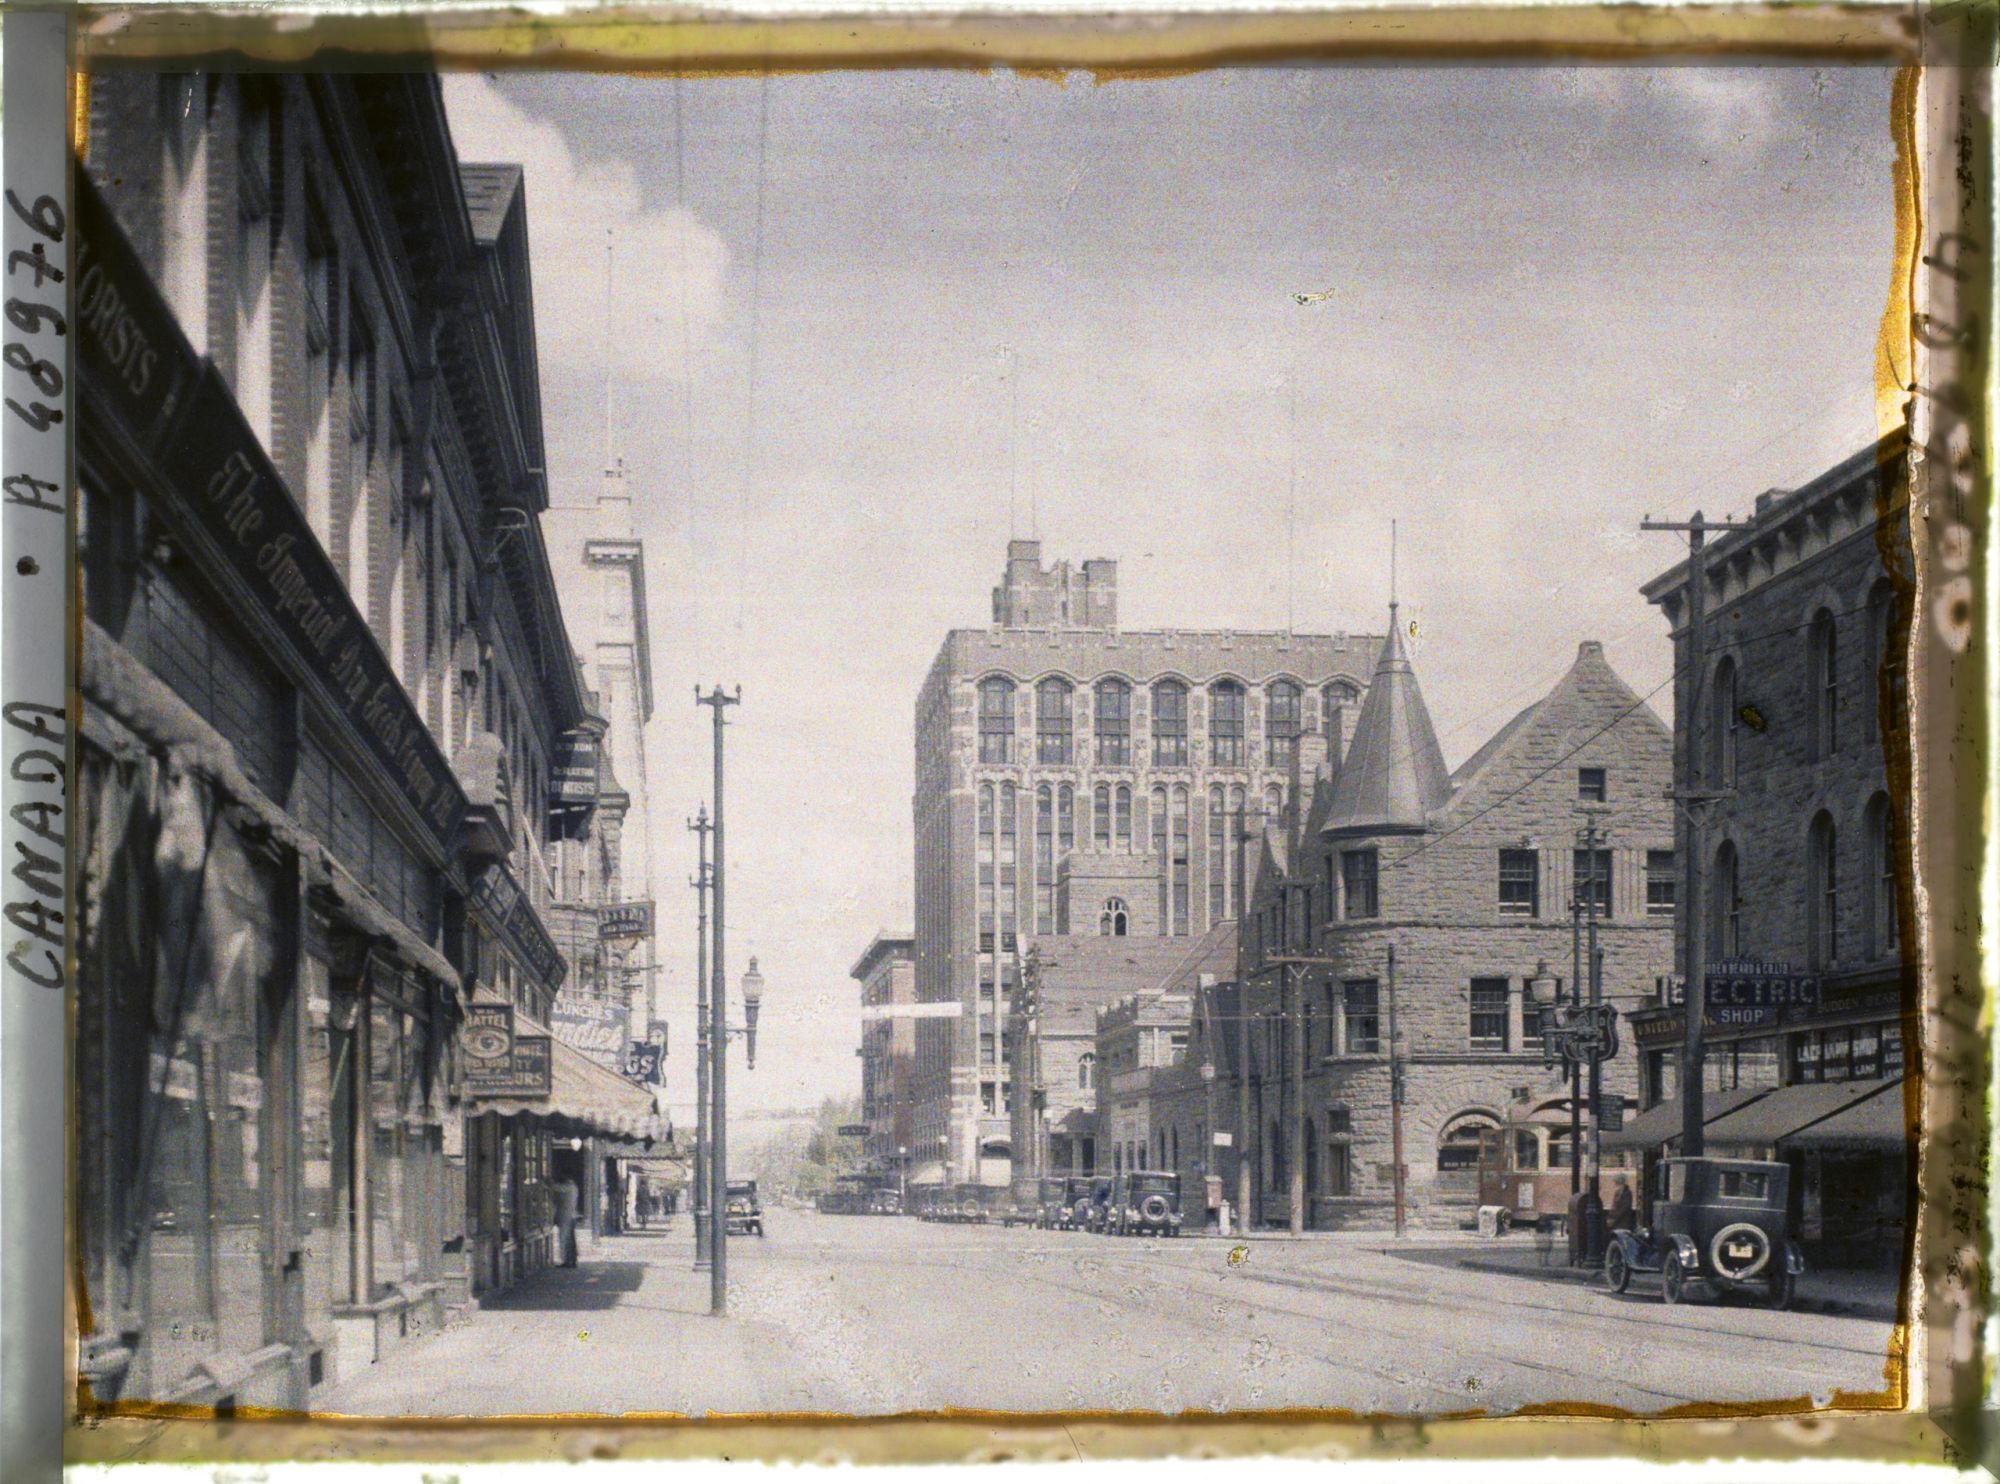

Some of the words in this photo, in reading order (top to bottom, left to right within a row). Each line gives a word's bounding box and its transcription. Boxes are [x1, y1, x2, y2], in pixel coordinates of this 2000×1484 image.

[2, 188, 67, 433] 48976
[208, 451, 263, 545] The
[2, 701, 66, 989] CANADA
[553, 999, 614, 1021] LUNCHES
[1671, 975, 1815, 1005] EECTRIC
[1721, 1009, 1764, 1024] SHOP
